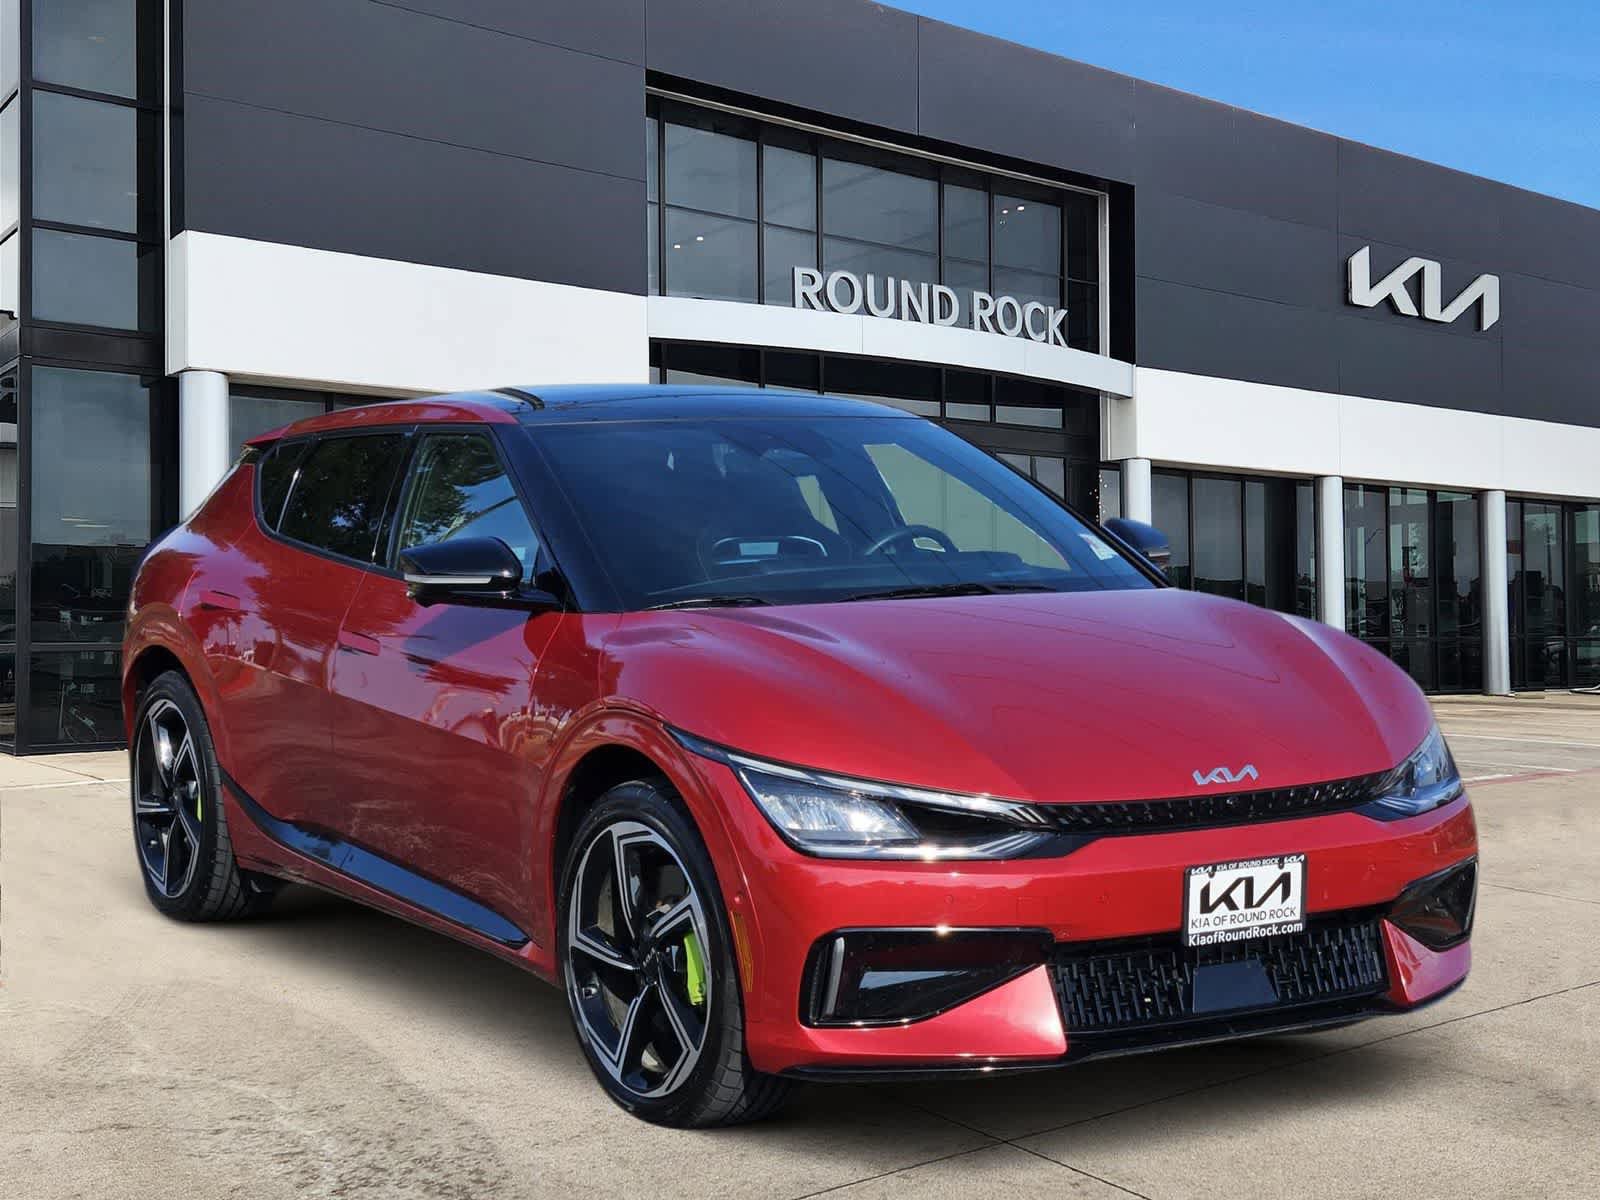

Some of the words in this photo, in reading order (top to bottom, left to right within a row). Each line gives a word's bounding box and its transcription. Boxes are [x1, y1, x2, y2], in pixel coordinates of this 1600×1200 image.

[1348, 245, 1500, 331] KIA
[792, 265, 960, 327] ROUND
[970, 289, 1069, 347] ROCK
[1192, 764, 1259, 785] KIA
[1216, 863, 1228, 872] KIA
[1228, 861, 1237, 870] OF
[1239, 858, 1261, 869] ROUND
[1262, 857, 1280, 865] ROCK
[1200, 872, 1291, 914] KIA
[1191, 917, 1210, 929] KIA
[1213, 914, 1228, 926] OF
[1230, 910, 1266, 924] ROUND
[1269, 906, 1296, 920] ROCK
[1188, 922, 1303, 947] KiaofRoundRock.com
